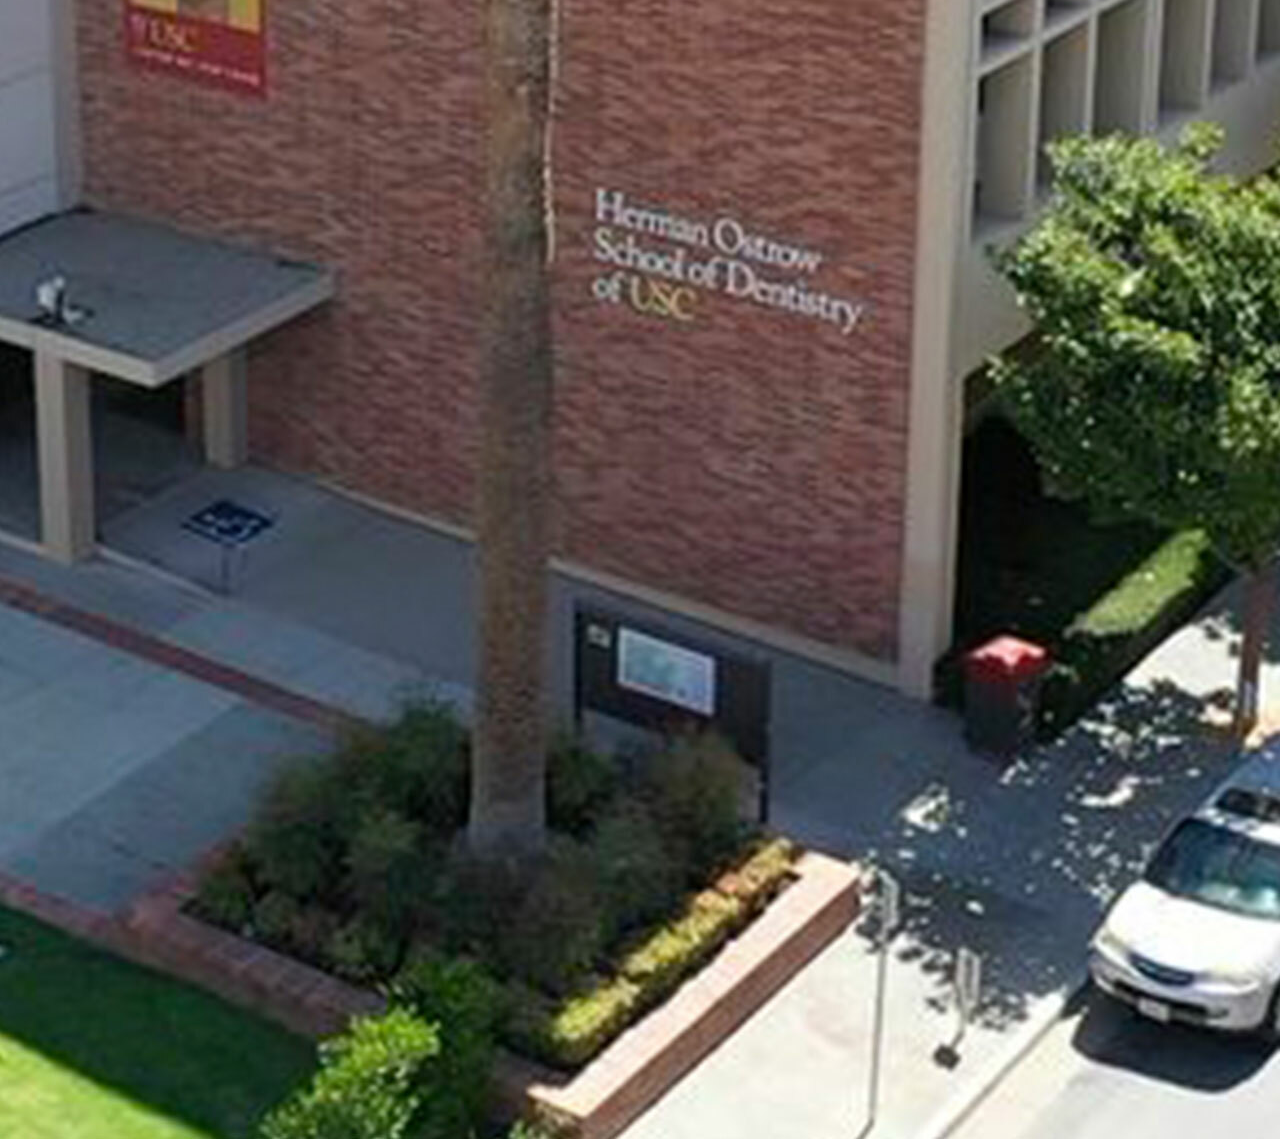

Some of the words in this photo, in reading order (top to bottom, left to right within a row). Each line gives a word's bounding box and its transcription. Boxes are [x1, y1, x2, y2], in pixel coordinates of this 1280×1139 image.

[595, 188, 708, 247] Herman
[713, 217, 822, 272] Ostrow
[592, 270, 625, 304] of
[631, 277, 698, 322] USC
[593, 226, 685, 281] School
[688, 255, 722, 289] of
[725, 261, 863, 335] Dentistry
